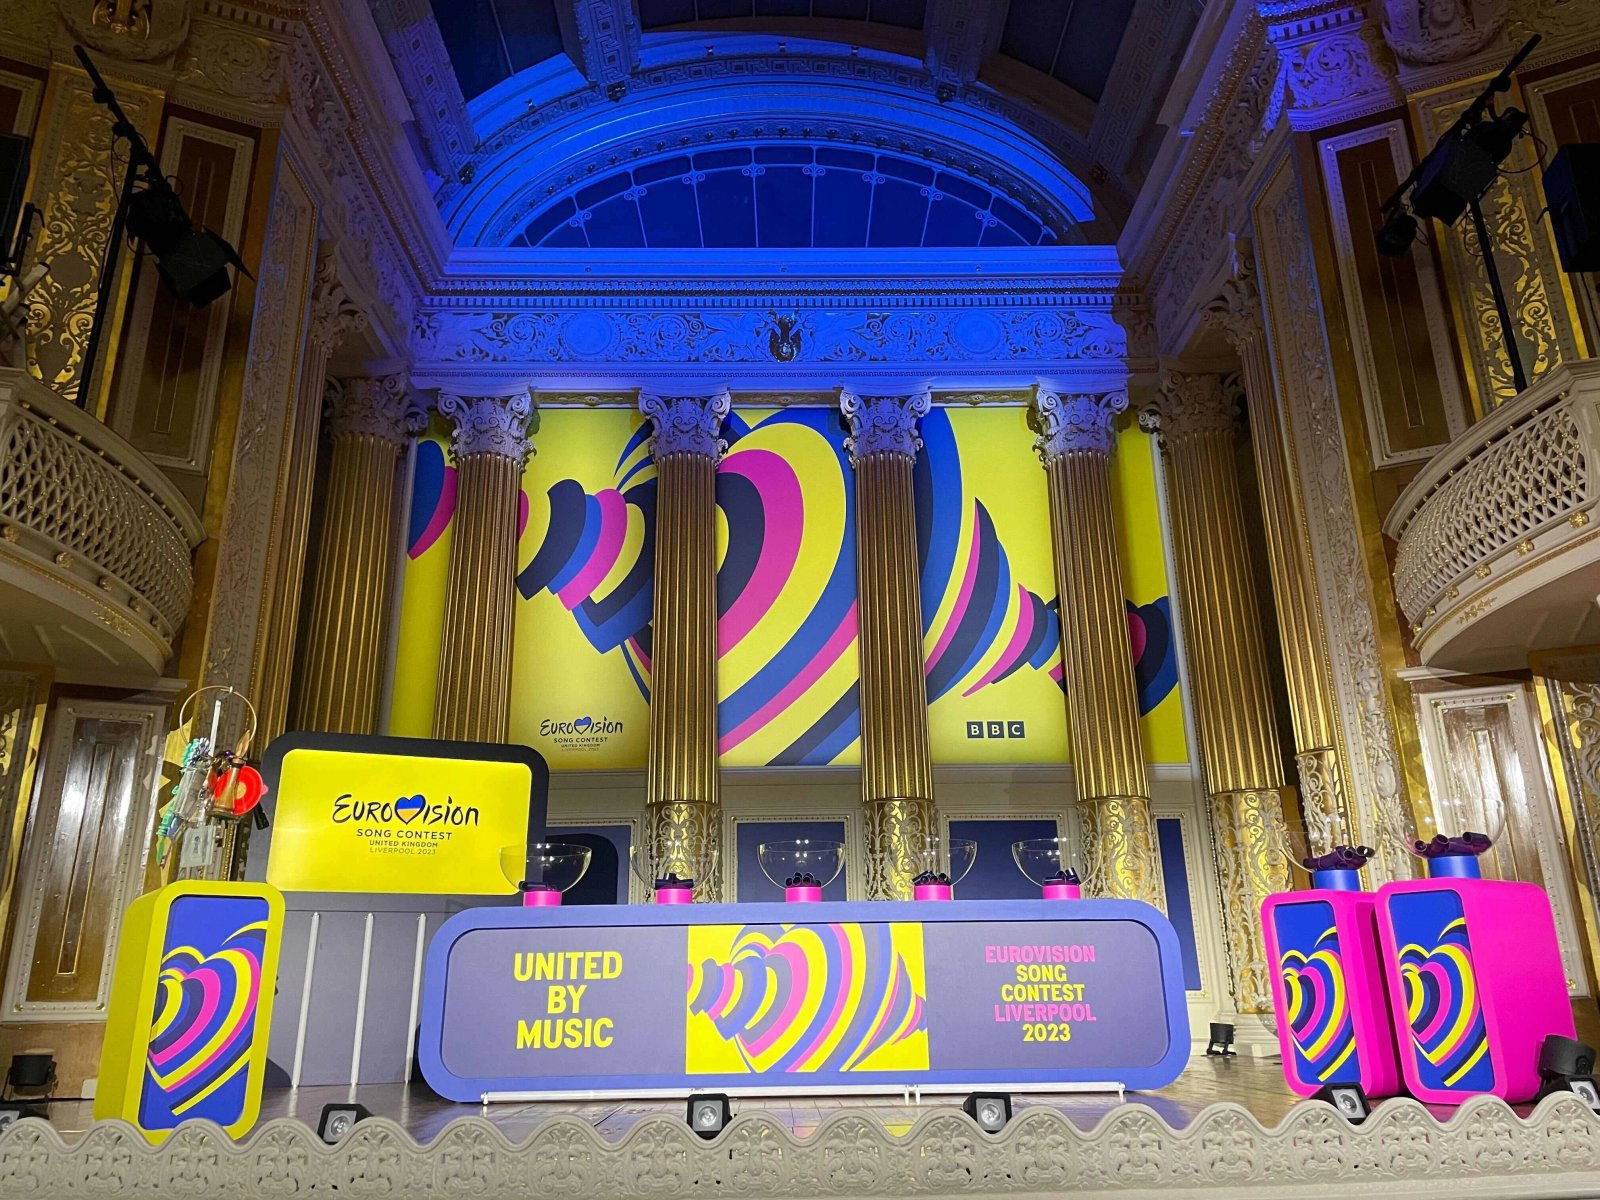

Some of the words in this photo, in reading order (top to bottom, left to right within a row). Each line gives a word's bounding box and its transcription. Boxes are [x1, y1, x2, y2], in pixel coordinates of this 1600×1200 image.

[969, 723, 1022, 736] BBC
[356, 828, 392, 838] SONG
[396, 830, 453, 840] CONTEST
[369, 847, 415, 855] LIVERPOOL
[401, 840, 439, 848] KINGDOM
[984, 944, 1096, 963] EUROVISION
[513, 950, 623, 982] UNITED
[1015, 964, 1068, 982] SONG
[547, 984, 588, 1014] BY
[1001, 983, 1085, 1002] CONTEST
[994, 1003, 1097, 1022] LIVERPOOL
[516, 1017, 614, 1049] MUSIC
[1022, 1023, 1071, 1042] 2023
